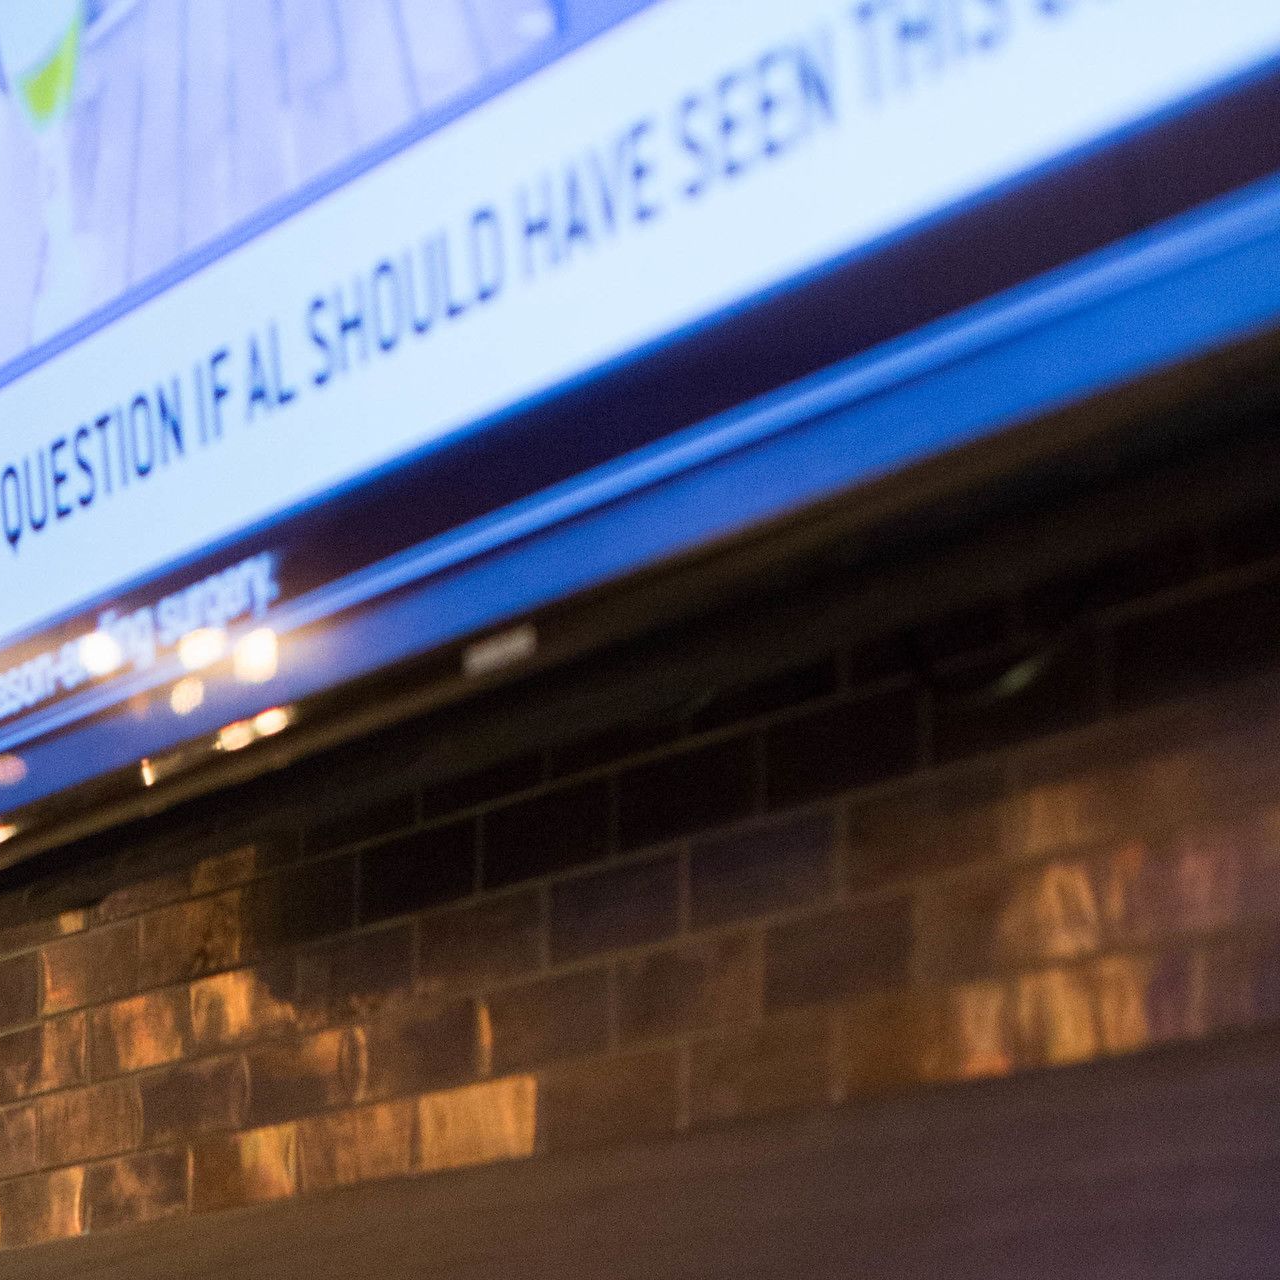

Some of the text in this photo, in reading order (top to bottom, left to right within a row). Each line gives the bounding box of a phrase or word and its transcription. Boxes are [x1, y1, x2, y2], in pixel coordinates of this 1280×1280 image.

[0, 374, 186, 555] QUESTION
[192, 350, 230, 447] IF
[244, 316, 297, 424] AL
[306, 201, 506, 388] SHOULD
[517, 116, 658, 283] HAVE
[677, 18, 839, 198] SEEN
